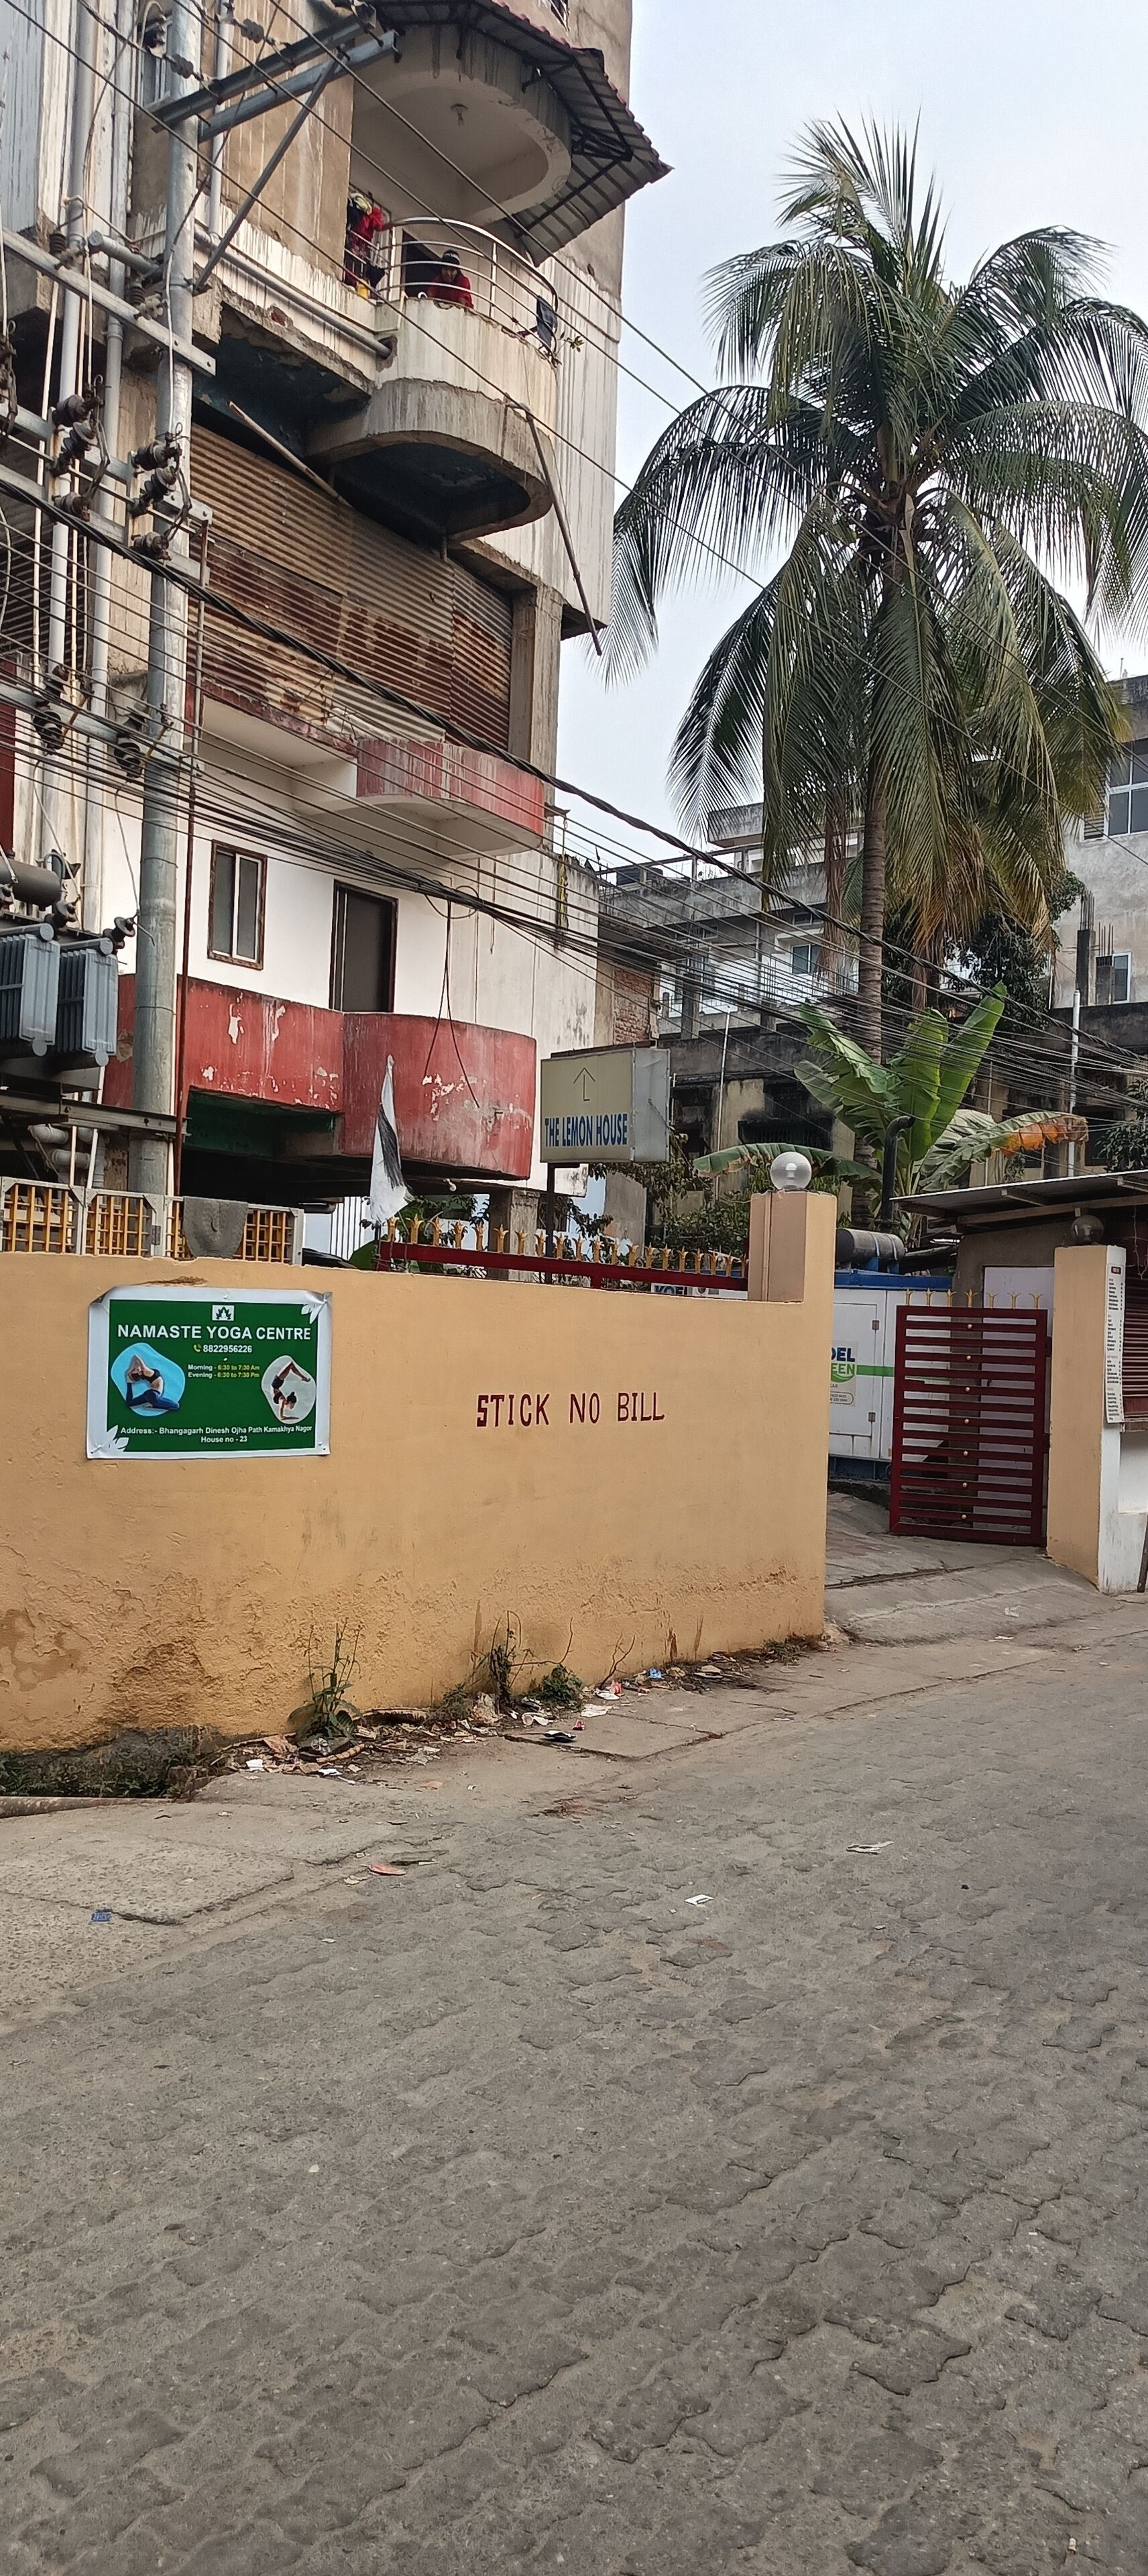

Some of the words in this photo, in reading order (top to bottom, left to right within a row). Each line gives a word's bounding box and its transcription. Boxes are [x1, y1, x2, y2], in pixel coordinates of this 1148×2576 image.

[544, 1118, 559, 1147] THE
[562, 1116, 593, 1146] LEMON
[596, 1114, 628, 1146] HOUSE
[117, 1324, 202, 1339] NAMASTE
[207, 1326, 252, 1339] YOGA
[256, 1327, 311, 1340] CENTRE
[203, 1344, 252, 1353] 8822956226
[188, 1364, 213, 1372] Morning
[476, 1393, 551, 1428] STICK
[569, 1392, 600, 1424] NO
[617, 1391, 665, 1422] BILL
[159, 1427, 204, 1436] Bhangagarh
[231, 1426, 247, 1435] Ojha
[248, 1426, 263, 1434] Path
[264, 1426, 294, 1434] Kamakhya
